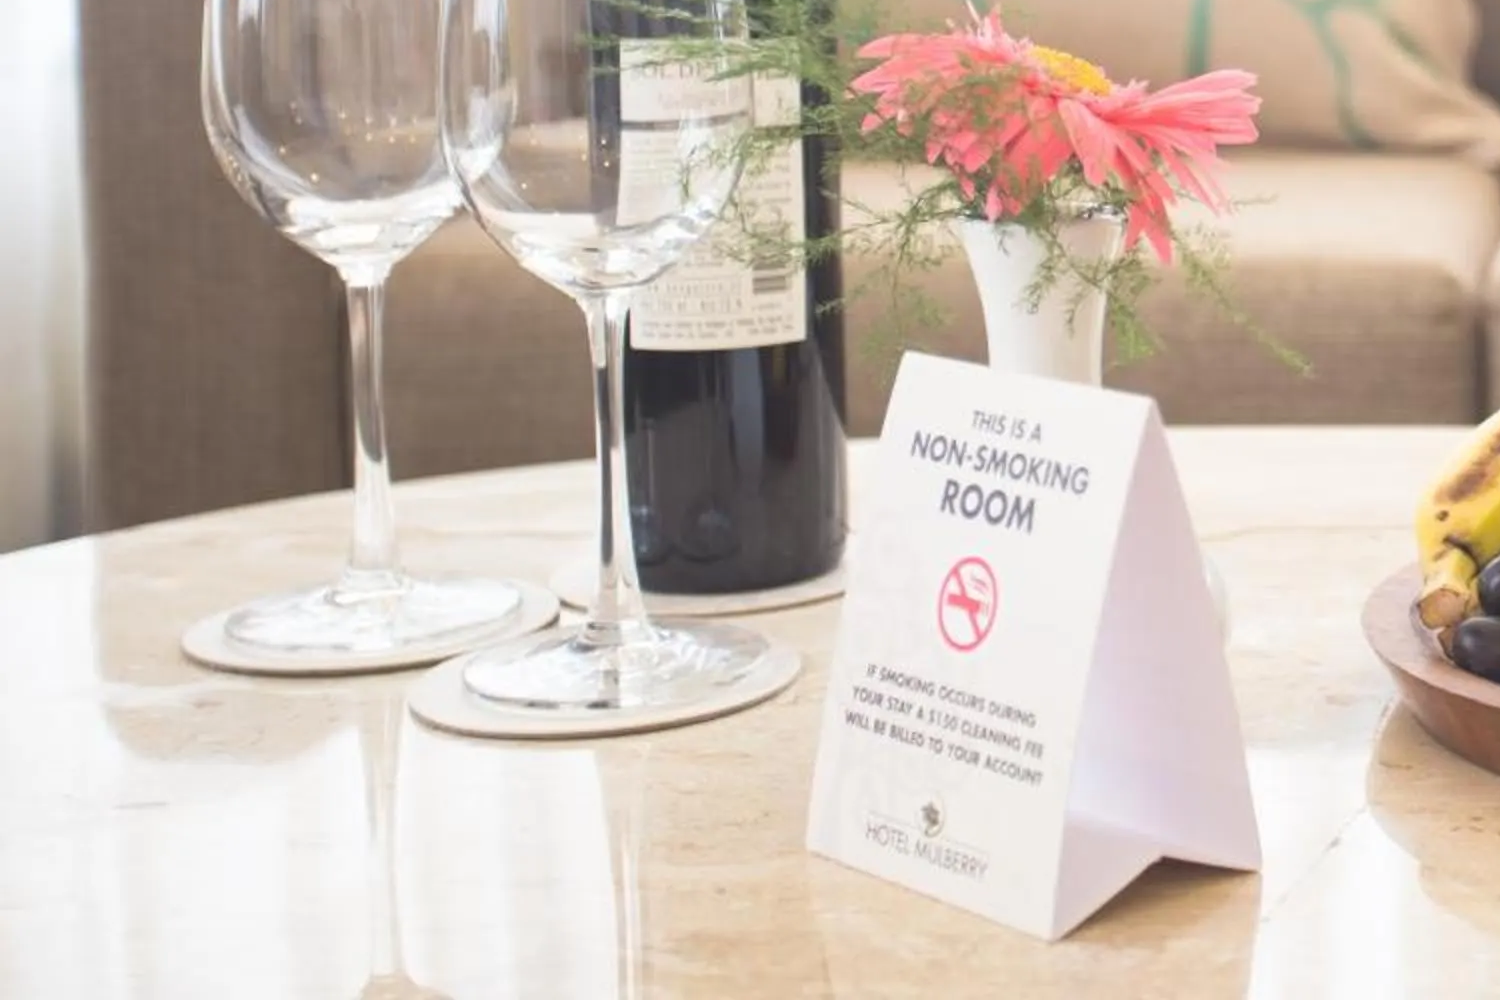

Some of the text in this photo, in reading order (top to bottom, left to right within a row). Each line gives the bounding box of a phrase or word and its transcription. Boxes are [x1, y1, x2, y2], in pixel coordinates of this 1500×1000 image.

[972, 409, 1042, 443] THIS IS A
[911, 429, 1089, 496] NON-SMOKING
[940, 478, 1036, 534] ROOM
[853, 685, 1043, 760] YOUR STAY A $150 CLEANING FEE
[866, 663, 1036, 729] IF SMOKING OCCURS DURING
[845, 710, 1044, 787] WILL BE BILLED TO YOUR ACCOUNT
[865, 819, 988, 878] HOTEL MULBERRY
